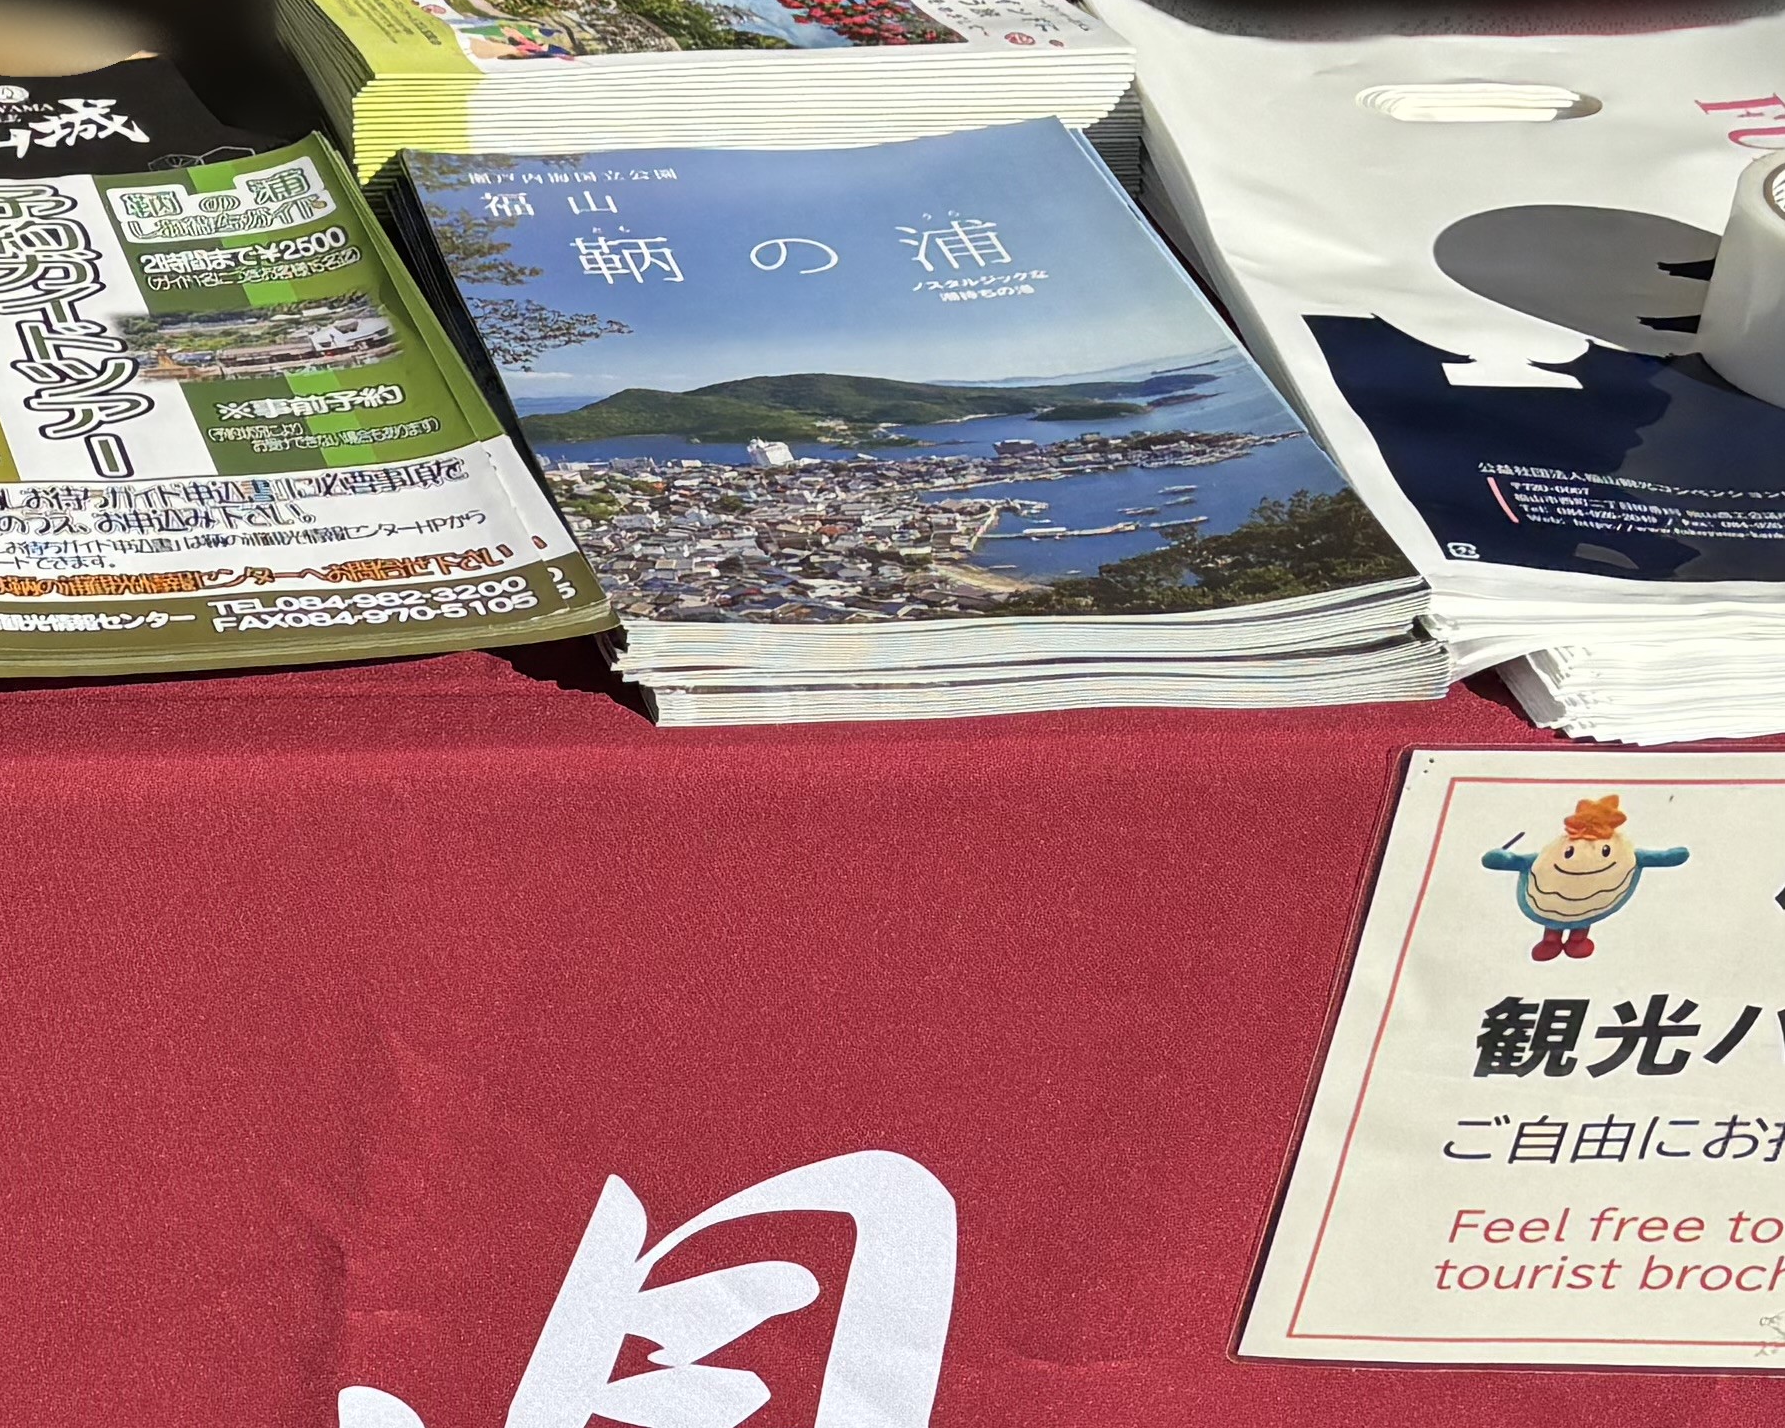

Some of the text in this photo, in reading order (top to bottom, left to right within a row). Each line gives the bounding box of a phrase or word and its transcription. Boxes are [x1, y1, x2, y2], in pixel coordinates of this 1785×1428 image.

[121, 168, 311, 219] 鞆の浦
[468, 167, 679, 185] 瀬戸内海国立公園
[481, 189, 619, 218] 福山
[140, 225, 348, 276] 2時間まで¥2500
[568, 218, 1015, 287] 鞆の浦
[911, 269, 1050, 294] ノスタルジックな
[216, 383, 405, 421] ※事前予約
[1478, 461, 1785, 500] 公益社団法人福山観光コンベンション
[207, 575, 528, 615] TEL084-982-3200
[212, 591, 540, 635] FAX084-970-5105
[1449, 1207, 1785, 1245] Feel free to
[1434, 1258, 1622, 1292] tourist
